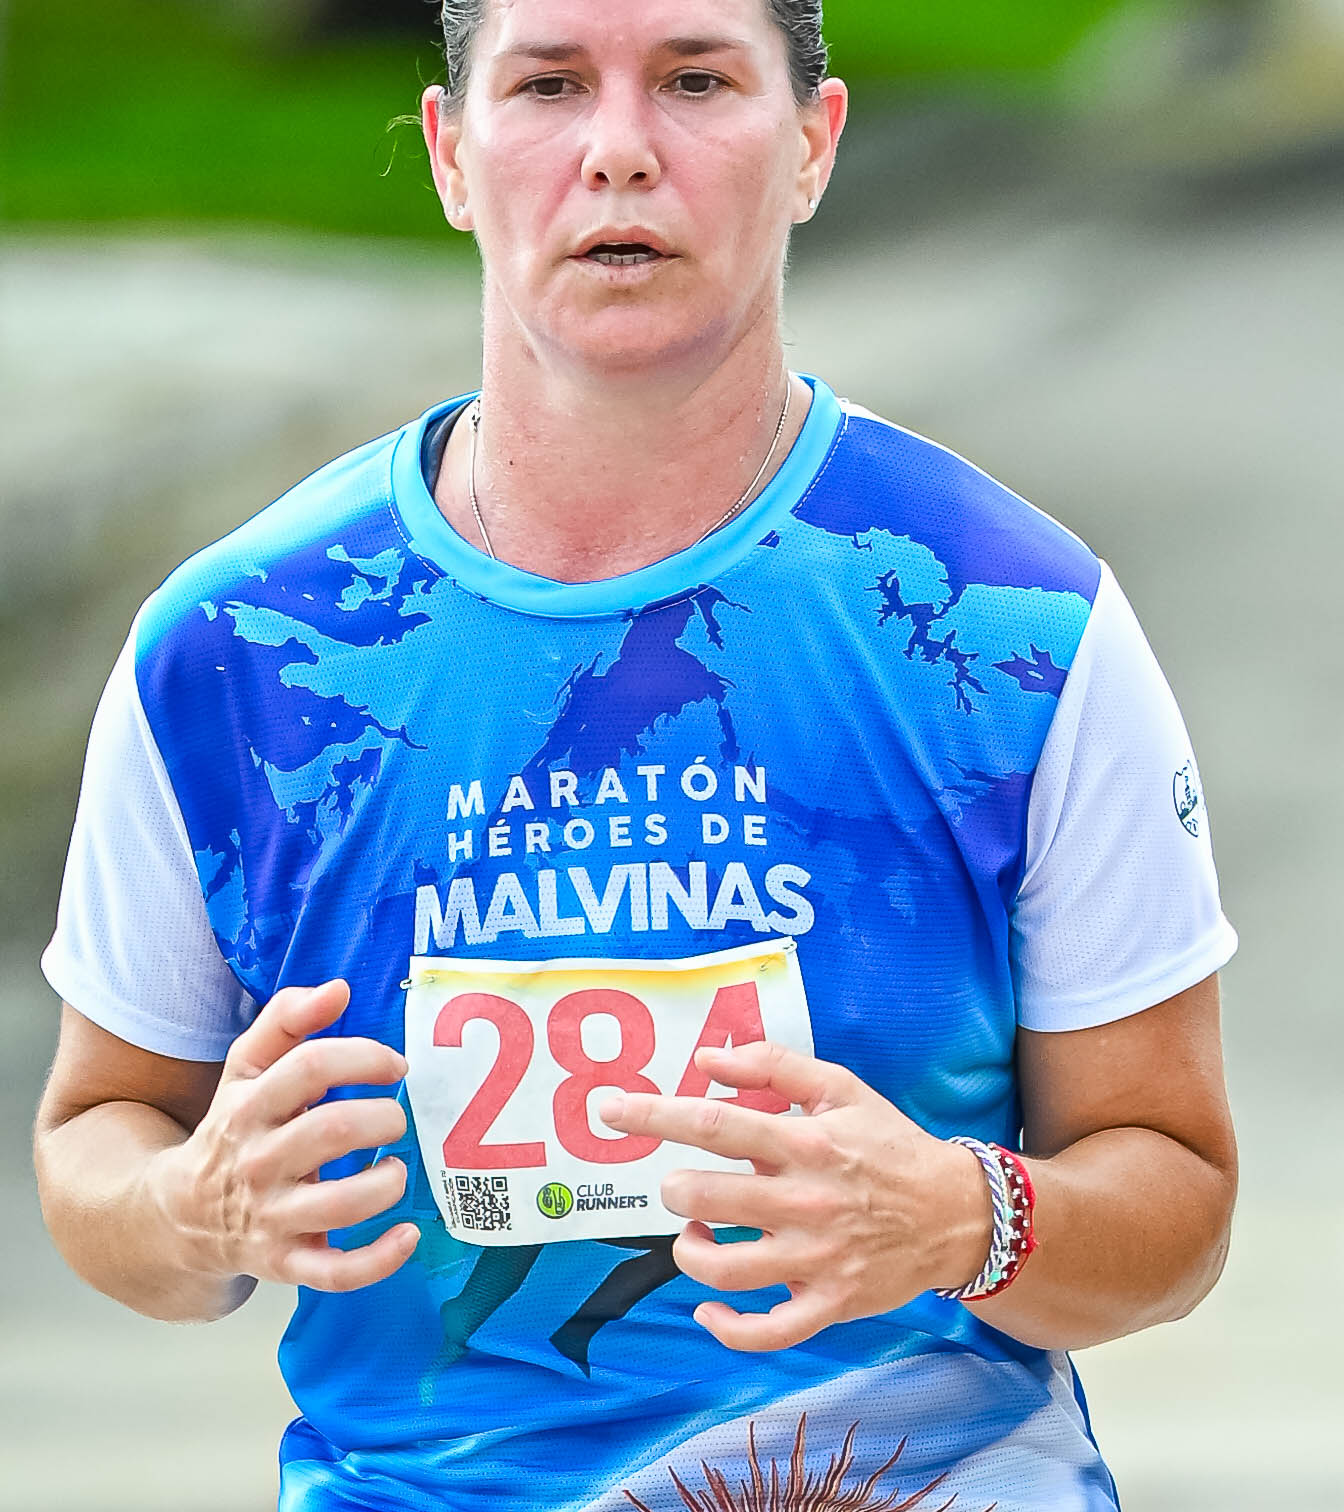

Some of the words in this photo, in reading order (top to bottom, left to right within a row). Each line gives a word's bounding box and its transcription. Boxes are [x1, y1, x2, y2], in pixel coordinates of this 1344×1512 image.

[446, 757, 766, 821] MARATÓN
[447, 814, 666, 862] HÉROES
[702, 815, 767, 846] DE
[414, 861, 815, 954] MALVINAS
[432, 981, 791, 1170] 284
[576, 1195, 648, 1211] RUNNER'S
[577, 1183, 614, 1197] CLUB
